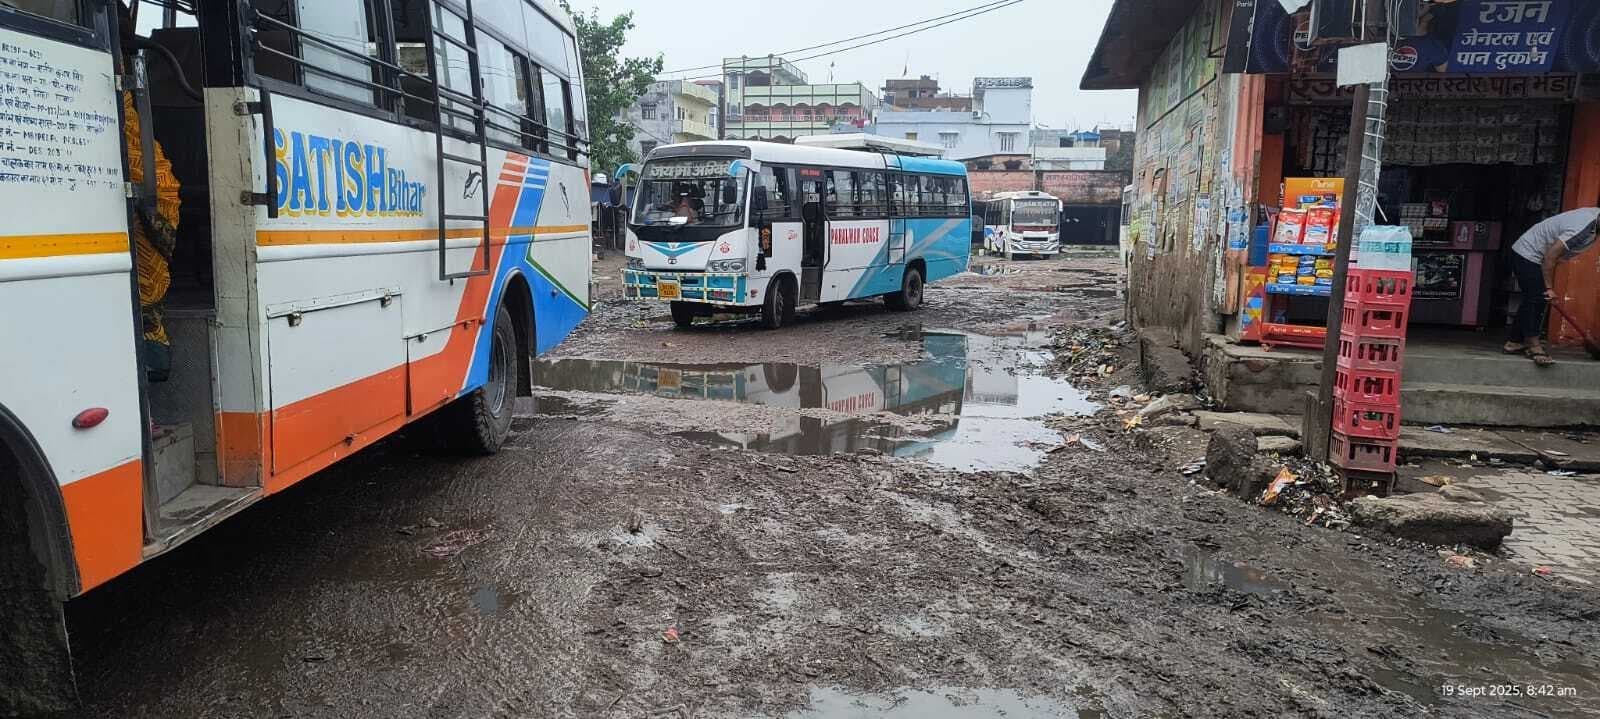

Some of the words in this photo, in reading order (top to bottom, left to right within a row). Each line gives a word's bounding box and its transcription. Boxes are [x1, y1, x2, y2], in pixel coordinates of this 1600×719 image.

[1461, 28, 1519, 46] जेनरल
[1526, 27, 1556, 46] एवं
[1456, 51, 1491, 65] पान
[1495, 51, 1549, 70] दुकान
[388, 167, 426, 212] Bihar
